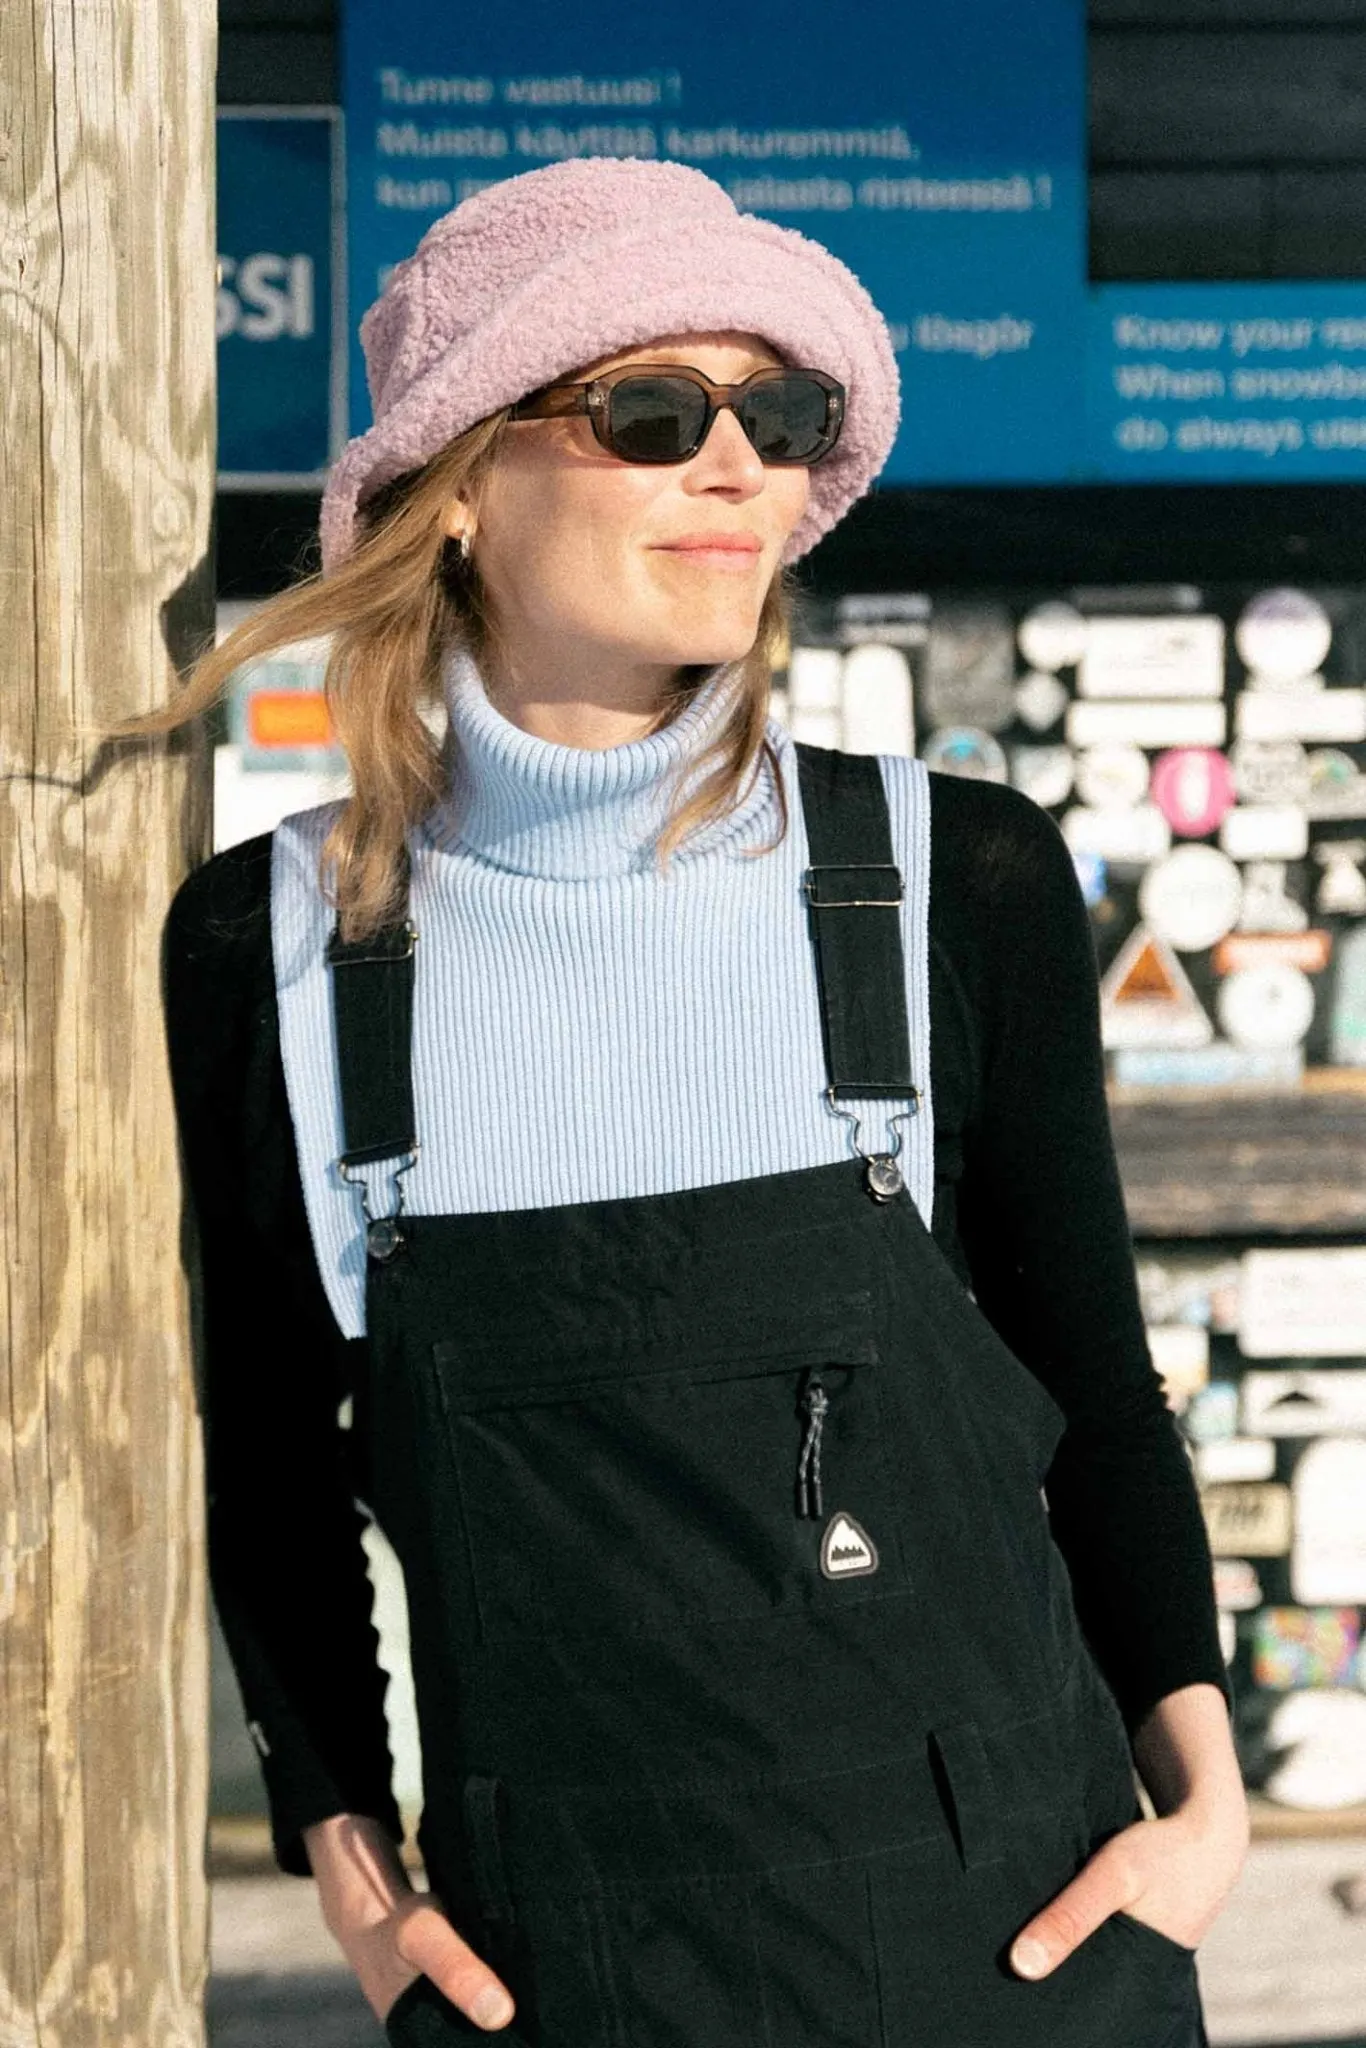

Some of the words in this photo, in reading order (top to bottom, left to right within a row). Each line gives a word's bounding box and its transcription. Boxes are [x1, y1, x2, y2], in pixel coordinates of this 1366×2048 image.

[379, 68, 492, 103] Tunne
[505, 73, 661, 104] vastuusi
[376, 121, 508, 158] Muista
[1114, 316, 1223, 350] Know
[1231, 318, 1313, 358] your
[1114, 364, 1226, 400] When
[1115, 415, 1169, 451] do
[1175, 416, 1305, 457] always
